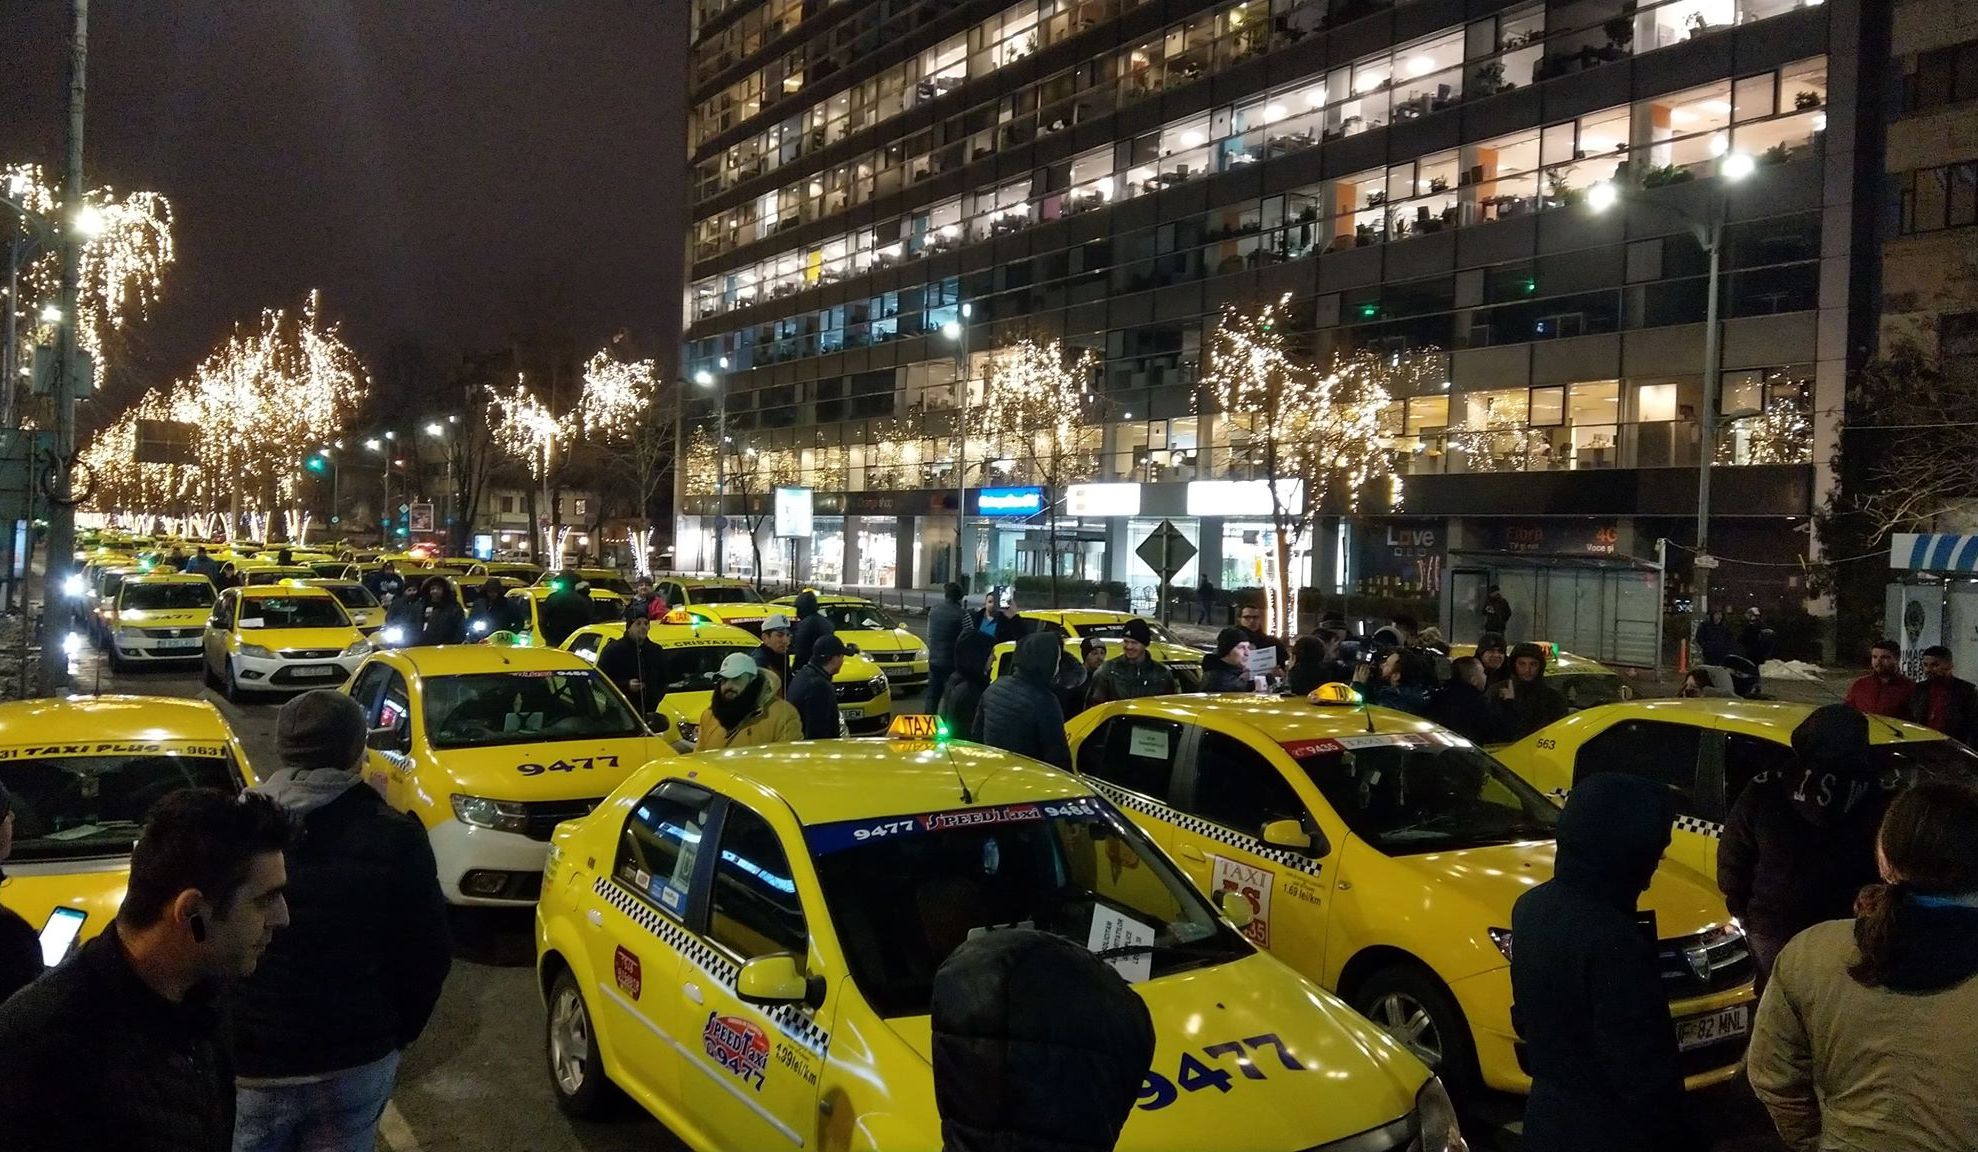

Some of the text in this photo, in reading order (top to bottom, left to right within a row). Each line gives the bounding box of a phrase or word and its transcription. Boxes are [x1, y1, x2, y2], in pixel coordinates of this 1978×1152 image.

[1387, 526, 1434, 546] Love
[1586, 543, 1605, 552] Voce
[673, 639, 734, 648] CRISTAXI
[904, 716, 938, 736] TAXI
[25, 745, 89, 756] TAXI
[98, 744, 160, 753] PLUS
[1306, 742, 1339, 755] 9435
[1536, 738, 1556, 750] 563
[517, 755, 619, 776] 9477
[853, 820, 913, 841] 9477
[1044, 803, 1095, 818] 9488
[1221, 861, 1266, 888] TAXI
[1699, 1018, 1715, 1039] 82
[1719, 1010, 1745, 1033] MNL
[716, 1045, 767, 1092] 9477
[1136, 1032, 1308, 1112] 9477
